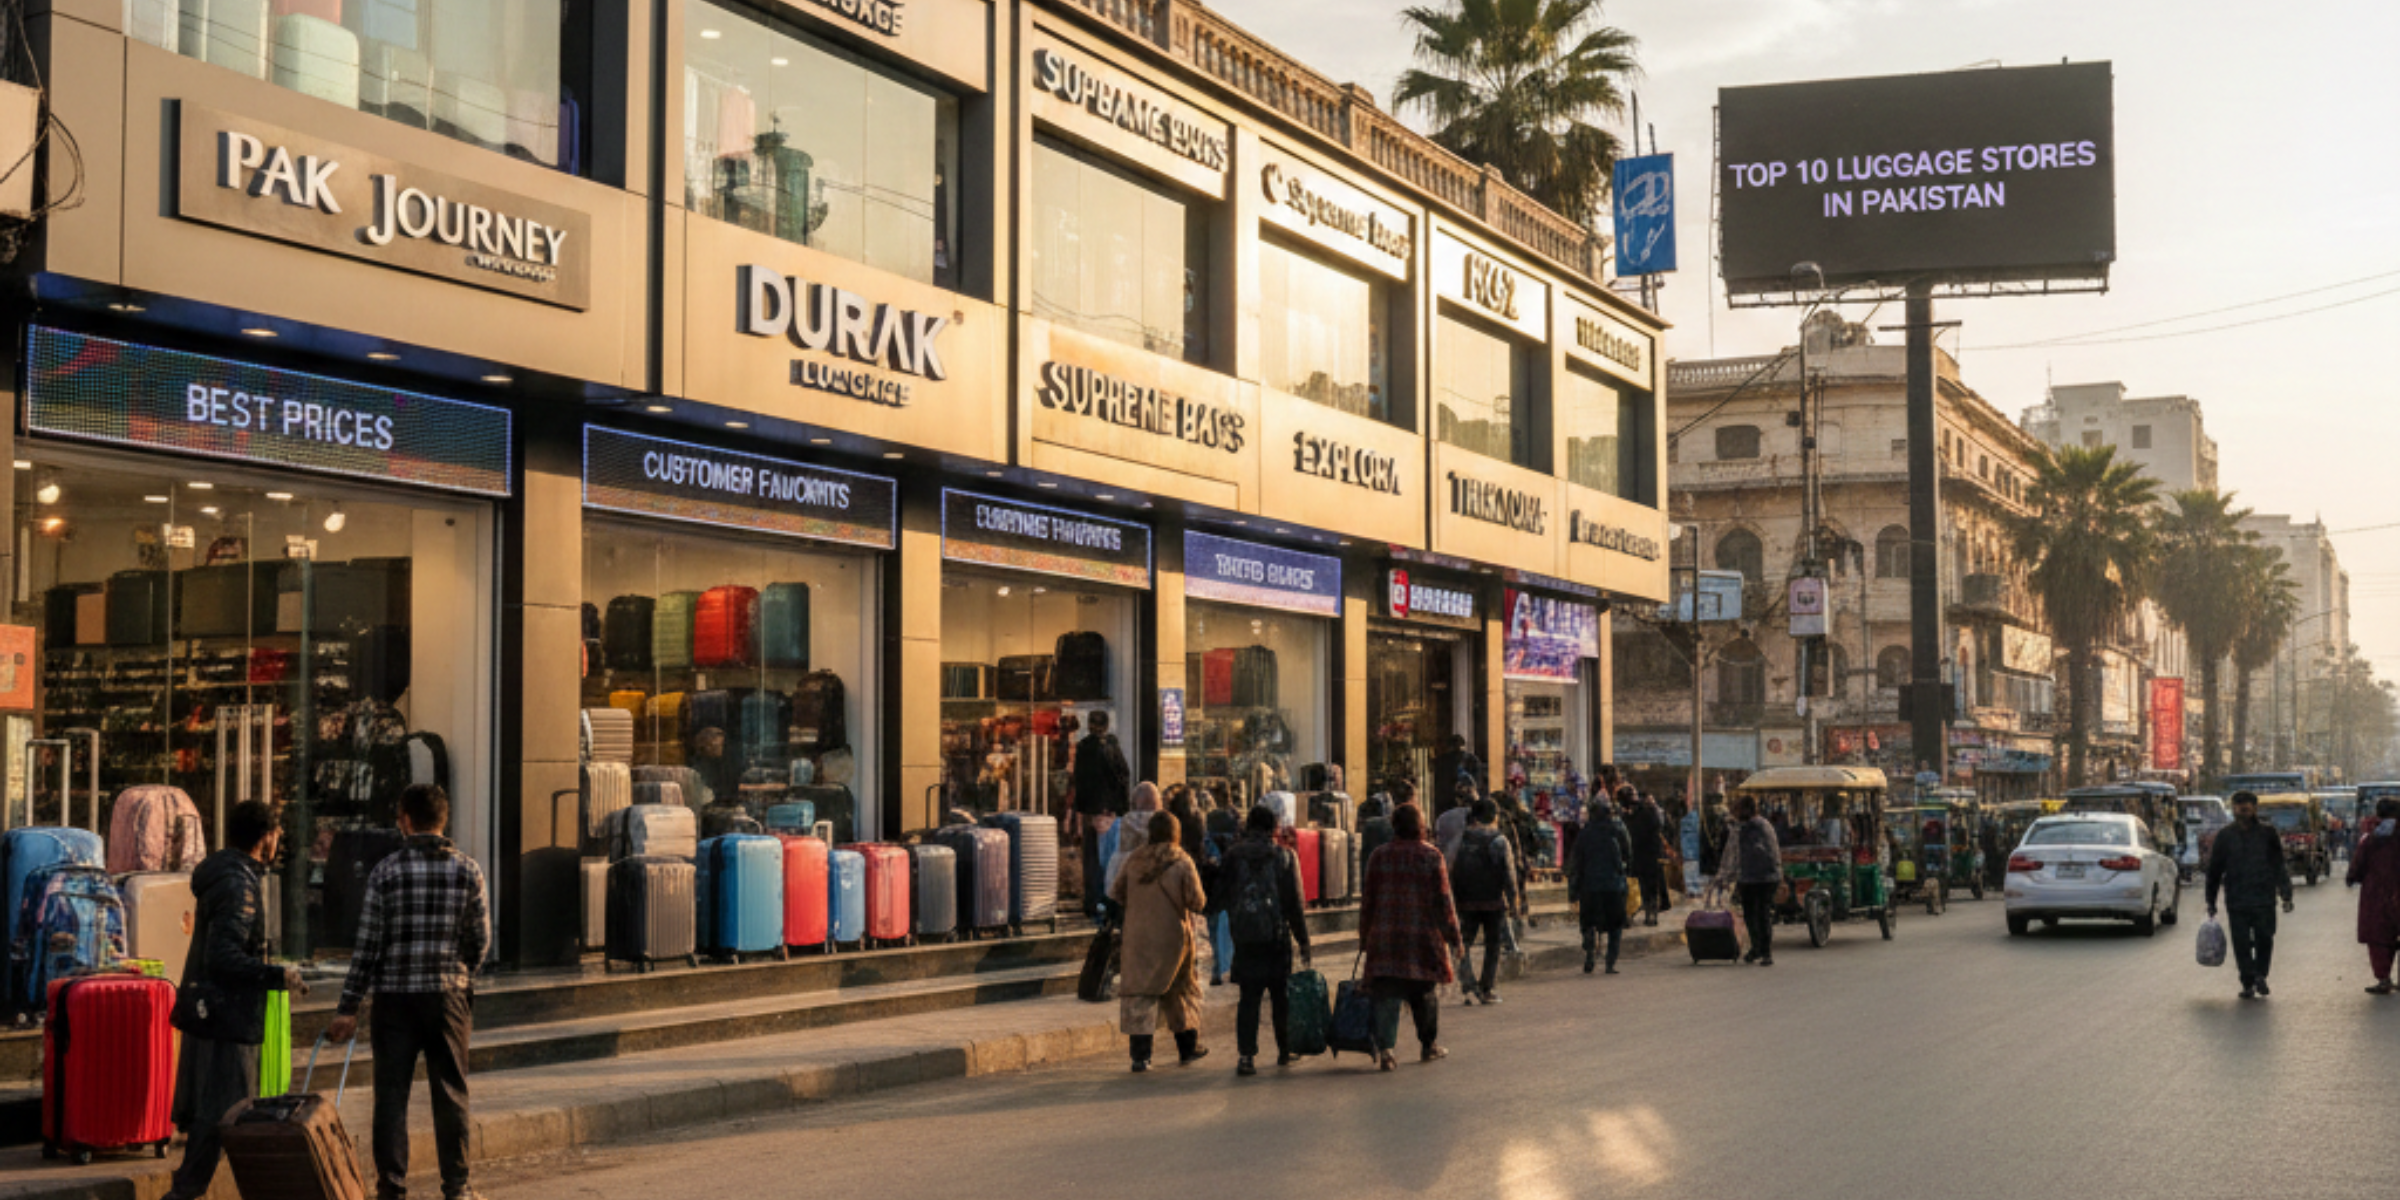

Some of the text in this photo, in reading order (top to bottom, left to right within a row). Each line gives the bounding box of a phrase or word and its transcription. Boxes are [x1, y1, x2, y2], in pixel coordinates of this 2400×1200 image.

[1729, 140, 2096, 189] TOP 10 LUGGAGE STORES
[218, 130, 567, 267] PAK JOURNEY
[1823, 181, 2005, 217] IN PAKISTAN
[737, 264, 947, 381] DURAK
[187, 382, 394, 450] BEST PRICES
[643, 451, 753, 494] CUSTOMER
